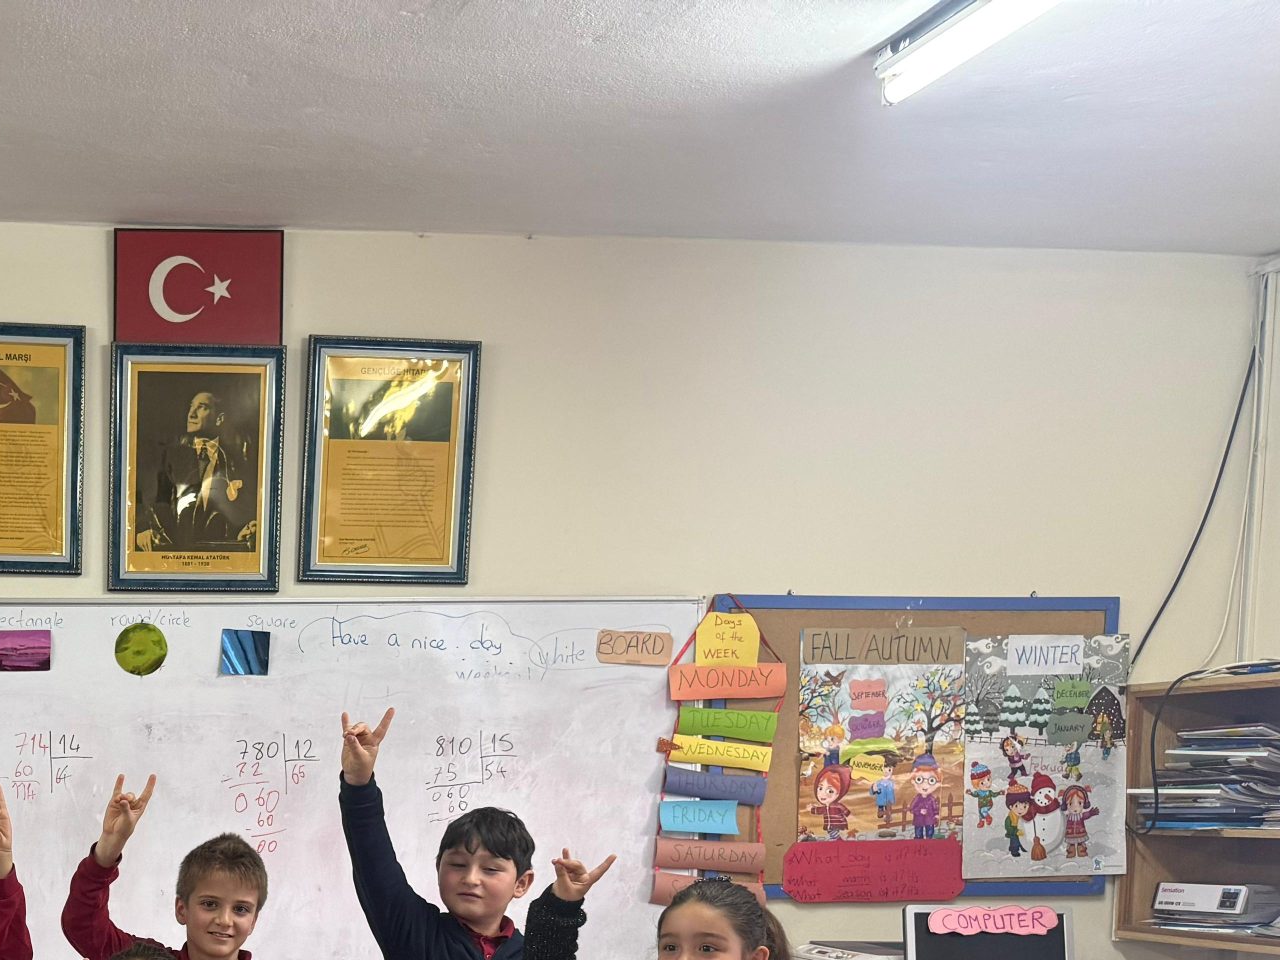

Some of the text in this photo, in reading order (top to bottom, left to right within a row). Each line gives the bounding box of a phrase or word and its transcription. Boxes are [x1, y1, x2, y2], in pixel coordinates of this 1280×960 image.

[5, 353, 32, 363] MARŞI
[247, 613, 297, 635] square
[715, 615, 743, 629] Days
[332, 616, 503, 655] Have a nice day
[715, 632, 744, 643] of the
[537, 632, 665, 667] white BOARD
[704, 648, 739, 659] WEEK
[1015, 643, 1081, 668] WINTER
[678, 668, 773, 691] MONDAY
[852, 689, 888, 700] SEPTEMBER
[1056, 688, 1090, 698] DECEMBER
[688, 710, 772, 731] TUESDAY
[1051, 723, 1085, 736] JANUARY
[15, 732, 80, 756] 714 14
[236, 739, 316, 761] 780 12
[436, 733, 514, 757] 810 15
[682, 742, 769, 764] WEDNESDAY
[291, 764, 306, 785] 65
[433, 761, 507, 783] 75 54
[852, 760, 885, 772] NOVEMBER
[672, 804, 728, 825] FRIDAY
[671, 844, 758, 865] SATURDAY
[942, 911, 1048, 931] COMPUTER
